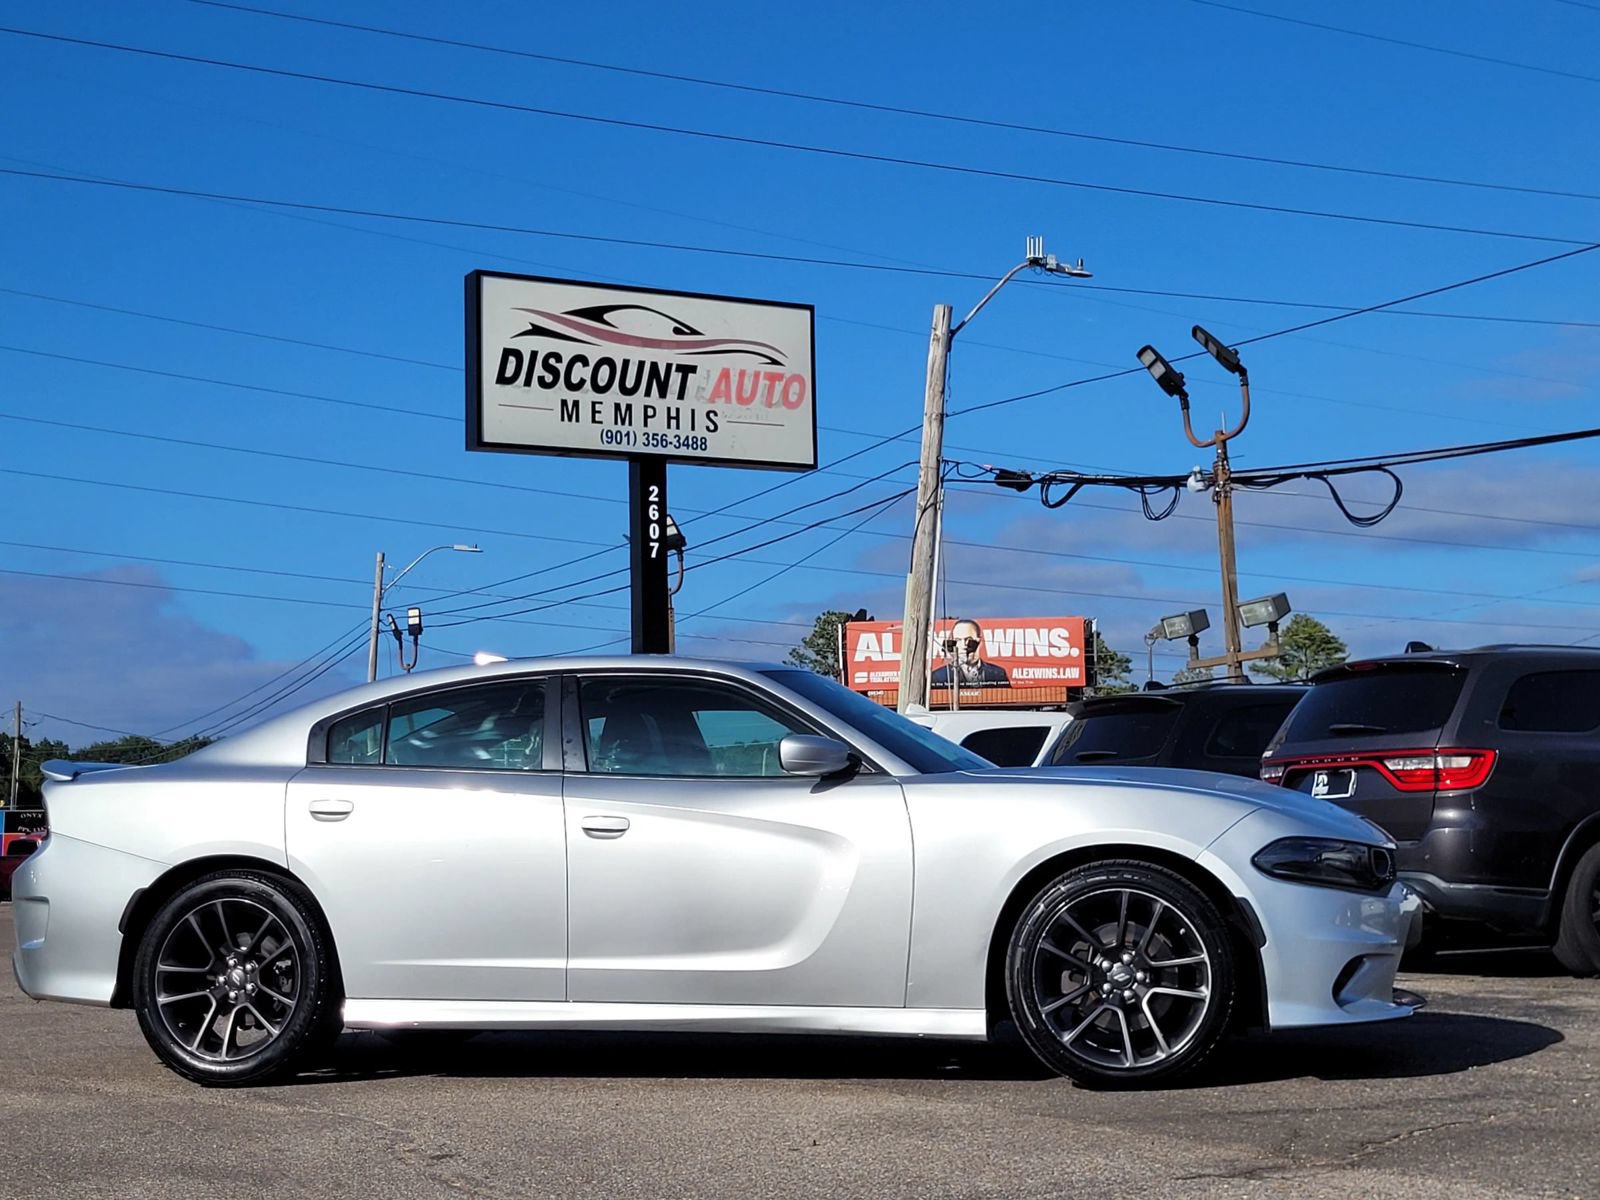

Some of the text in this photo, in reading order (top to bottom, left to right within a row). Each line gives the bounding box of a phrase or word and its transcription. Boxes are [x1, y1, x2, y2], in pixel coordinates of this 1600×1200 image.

[495, 347, 806, 410] DISCOUNT AUTO
[560, 399, 719, 433] MEMPHIS
[600, 428, 708, 451] (901) 356-3488
[648, 485, 660, 558] 2607
[854, 628, 1080, 662] ALX WINS.
[1012, 667, 1080, 679] ALEXWINS.LAW
